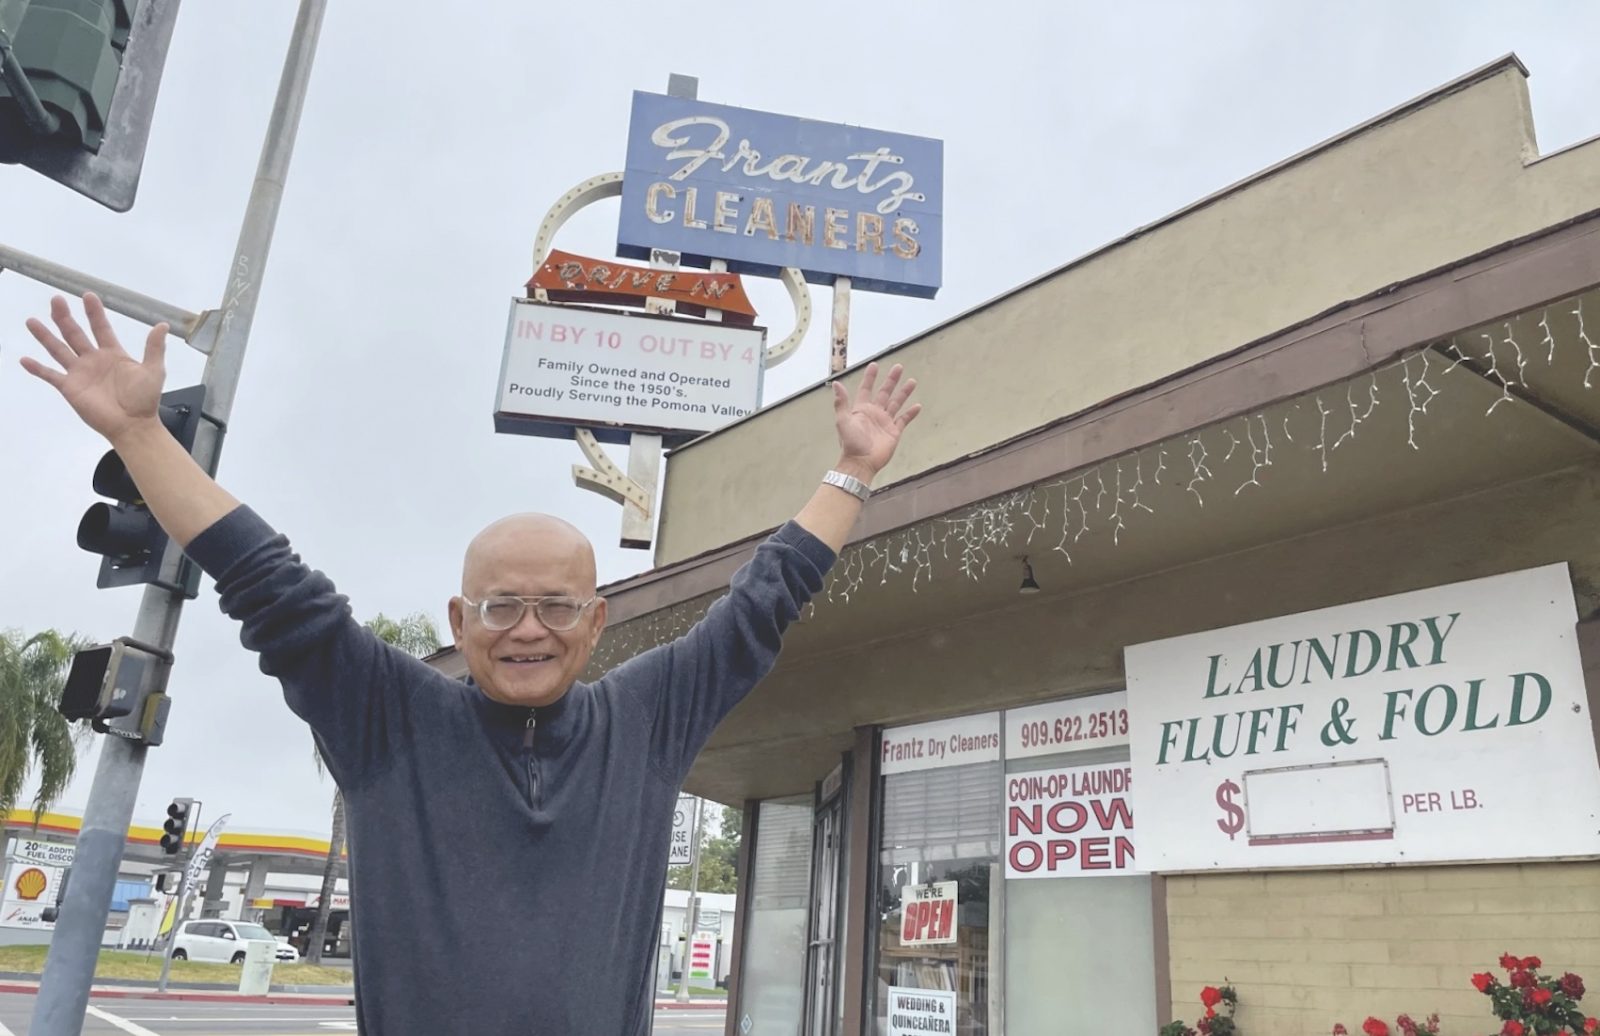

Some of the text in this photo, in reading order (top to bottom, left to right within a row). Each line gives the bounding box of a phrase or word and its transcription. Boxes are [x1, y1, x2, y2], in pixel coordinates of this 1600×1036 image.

[651, 116, 926, 214] Frantz
[645, 182, 921, 260] CLEANERS
[559, 261, 731, 299] DRIVE IN
[517, 320, 755, 364] IN BY 10 OUT BY 4
[538, 358, 731, 388] Family Owned and Operated
[570, 375, 687, 398] Since the 1950's.
[509, 383, 752, 417] Proudly Serving the Pomona Valley
[1203, 612, 1461, 699] LAUNDRY
[1021, 709, 1129, 748] 909.622.2513
[1156, 672, 1553, 765] FLUFF & FOLD
[883, 733, 999, 763] Frantz Dry Cleaners
[1009, 774, 1068, 802] COIN-OP
[1009, 797, 1134, 836] NOW
[1215, 778, 1484, 840] $ PER LB.
[24, 841, 39, 851] 20
[26, 851, 46, 859] FUEL
[670, 845, 689, 857] ANE
[1009, 836, 1136, 873] OPEN
[915, 887, 943, 899] WE'RE
[903, 899, 954, 941] OPEN
[897, 996, 945, 1013] WEDDING &
